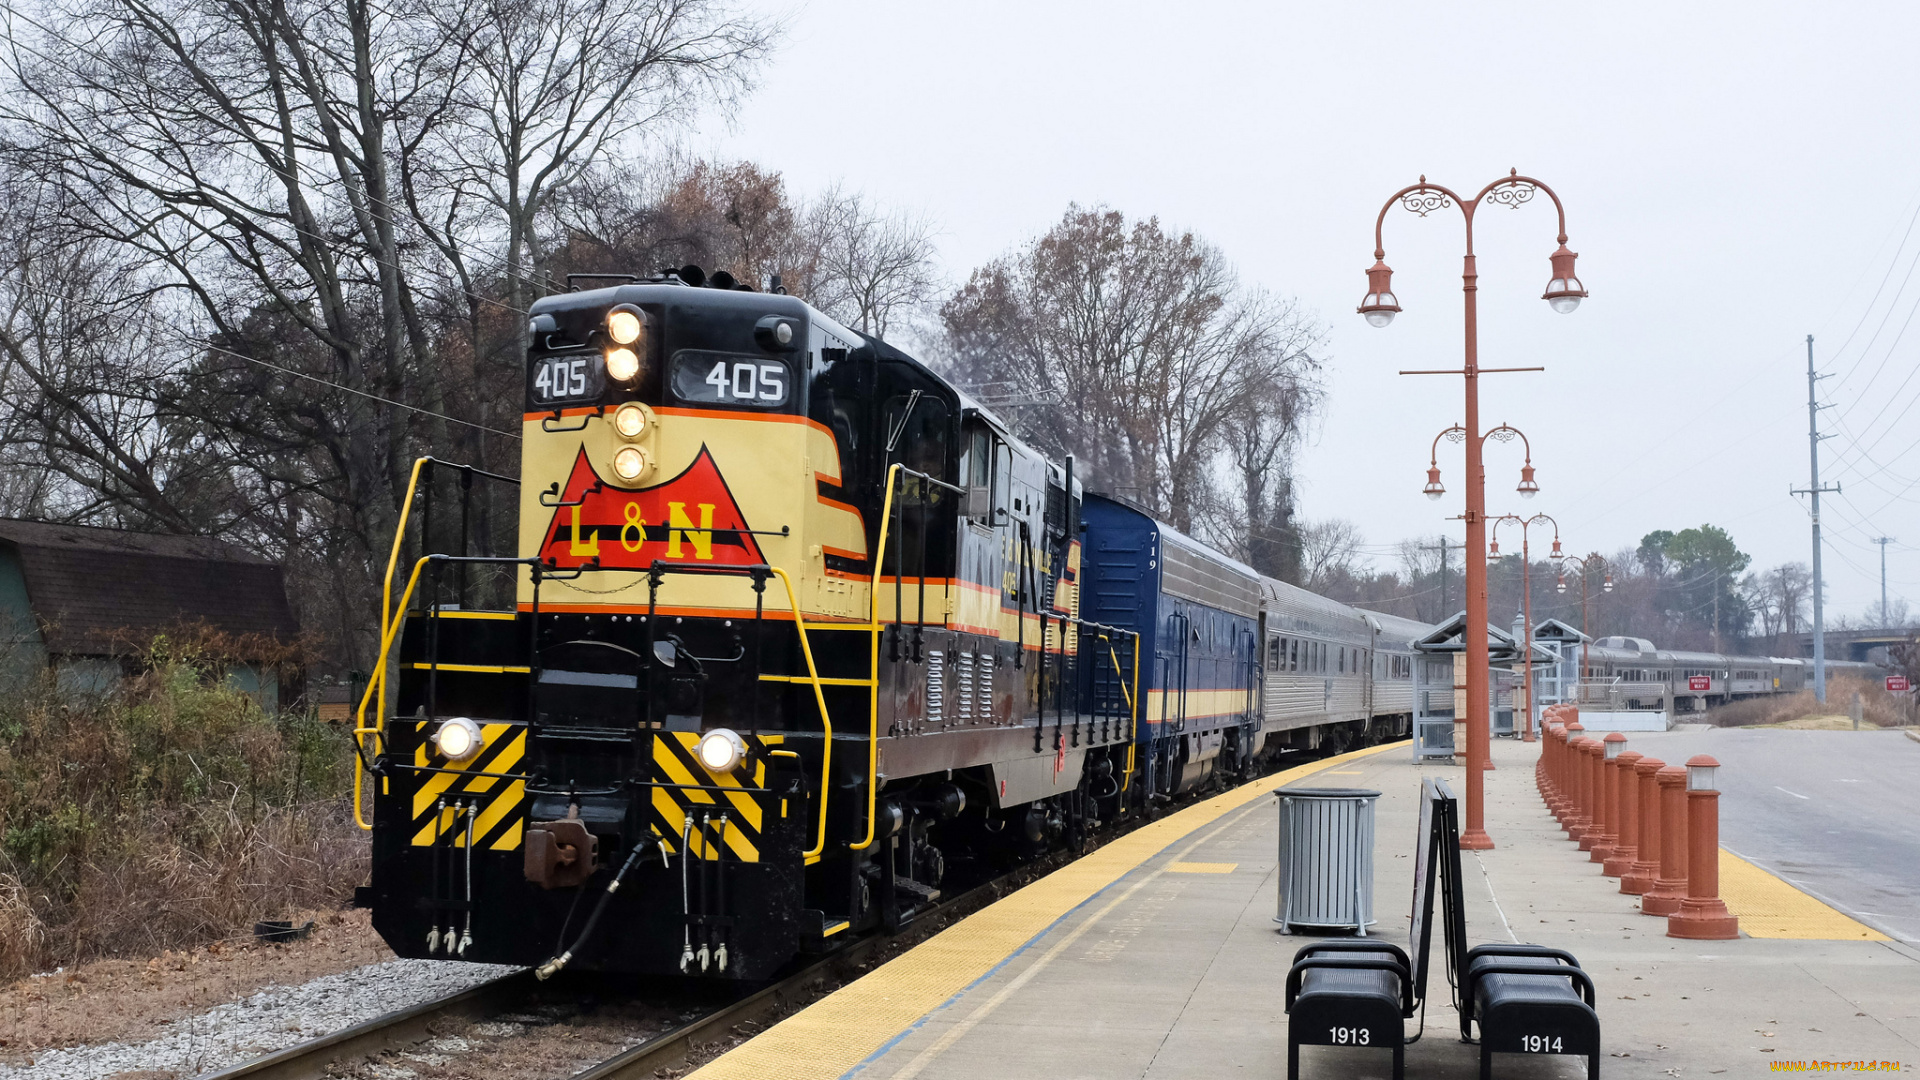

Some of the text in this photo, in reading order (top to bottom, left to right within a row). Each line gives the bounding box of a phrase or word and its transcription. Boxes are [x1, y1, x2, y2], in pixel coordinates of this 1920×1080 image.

[535, 360, 587, 398] 405
[705, 361, 784, 401] 405
[568, 501, 716, 560] L & N
[1149, 531, 1157, 570] 719
[1329, 1026, 1370, 1046] 1913
[1521, 1035, 1563, 1053] 1914
